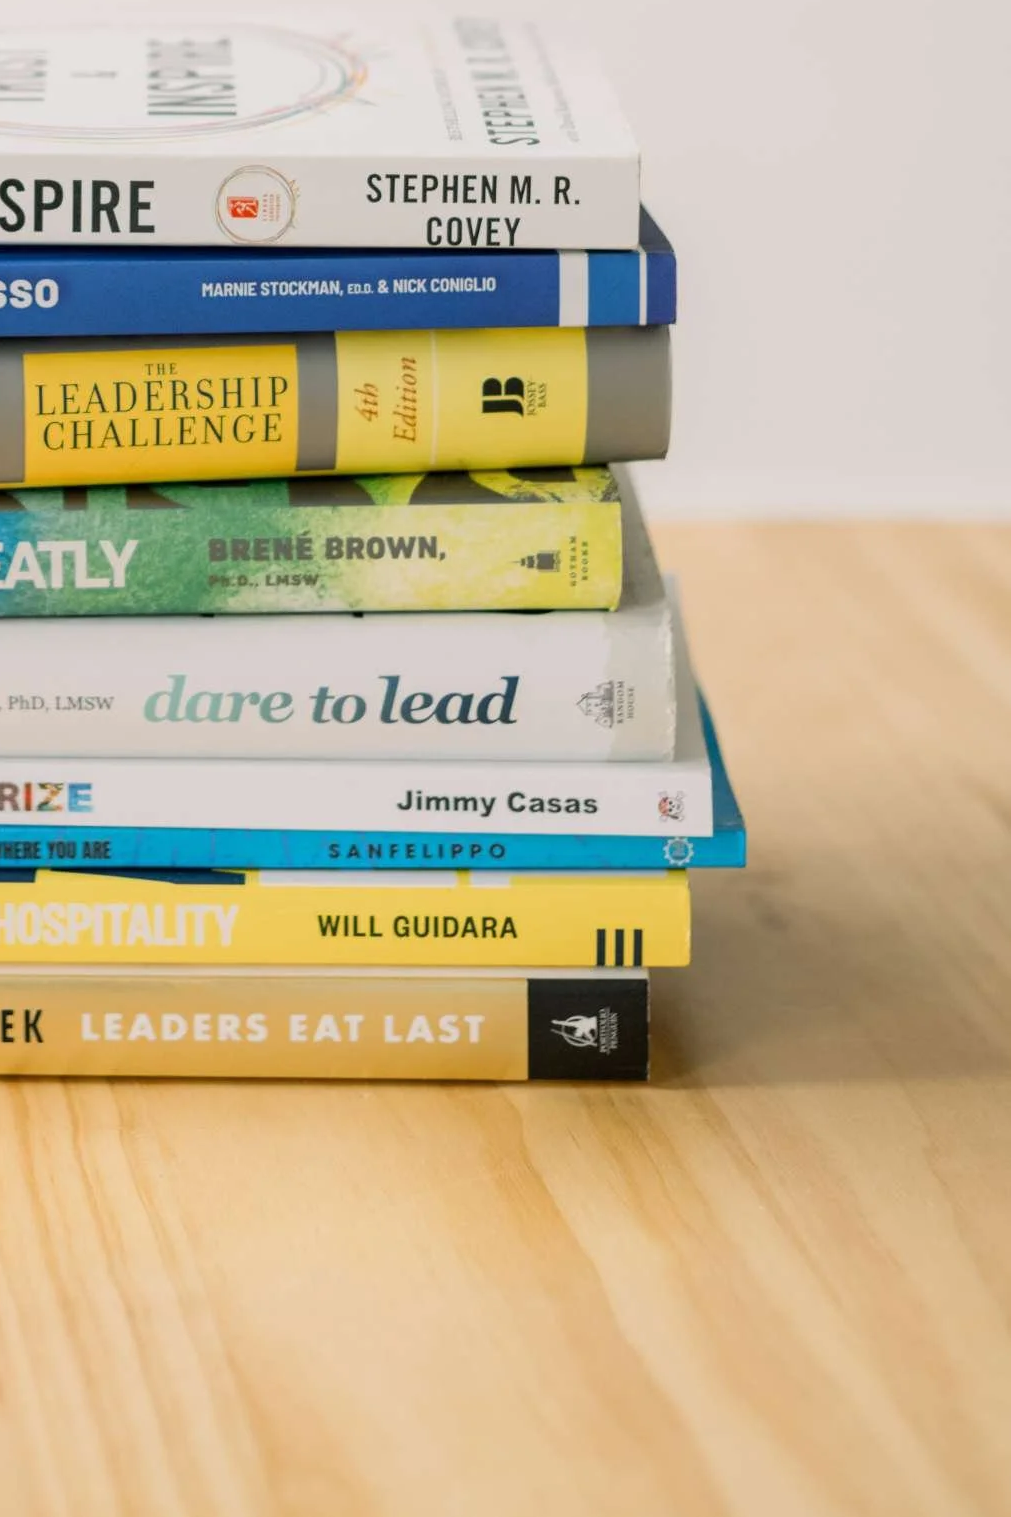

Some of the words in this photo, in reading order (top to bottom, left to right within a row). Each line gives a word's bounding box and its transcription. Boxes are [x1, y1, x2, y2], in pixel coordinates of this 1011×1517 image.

[367, 174, 497, 203] STEPHEN
[511, 176, 540, 204] M.
[554, 176, 579, 204] R.
[427, 217, 520, 246] COVEY
[202, 282, 257, 297] MARNIE
[261, 281, 343, 296] STOCKMAN,
[378, 280, 389, 293] &
[393, 279, 426, 293] NICK
[430, 277, 496, 292] CONIGLIO
[145, 363, 176, 375] THE
[36, 376, 288, 416] LEADERSHIP
[354, 383, 378, 422] 4th
[393, 357, 417, 443] Edition
[43, 415, 282, 450] CHALLENGE
[208, 531, 314, 562] BRENÉ
[325, 536, 446, 563] BROWN,
[265, 573, 320, 587] LMSW
[56, 696, 114, 711] LMSW
[144, 675, 294, 723] dare
[310, 687, 366, 723] to
[379, 676, 519, 724] lead
[397, 791, 496, 817] Jimmy
[508, 792, 597, 813] Casas
[47, 839, 77, 859] YOU
[82, 840, 111, 859] ARE
[329, 842, 506, 859] SANFELIPPO
[318, 915, 383, 937] WILL
[394, 916, 517, 938] GUIDARA
[82, 1013, 268, 1042] LEADERS
[290, 1014, 364, 1042] EAT
[384, 1015, 485, 1043] LAST
